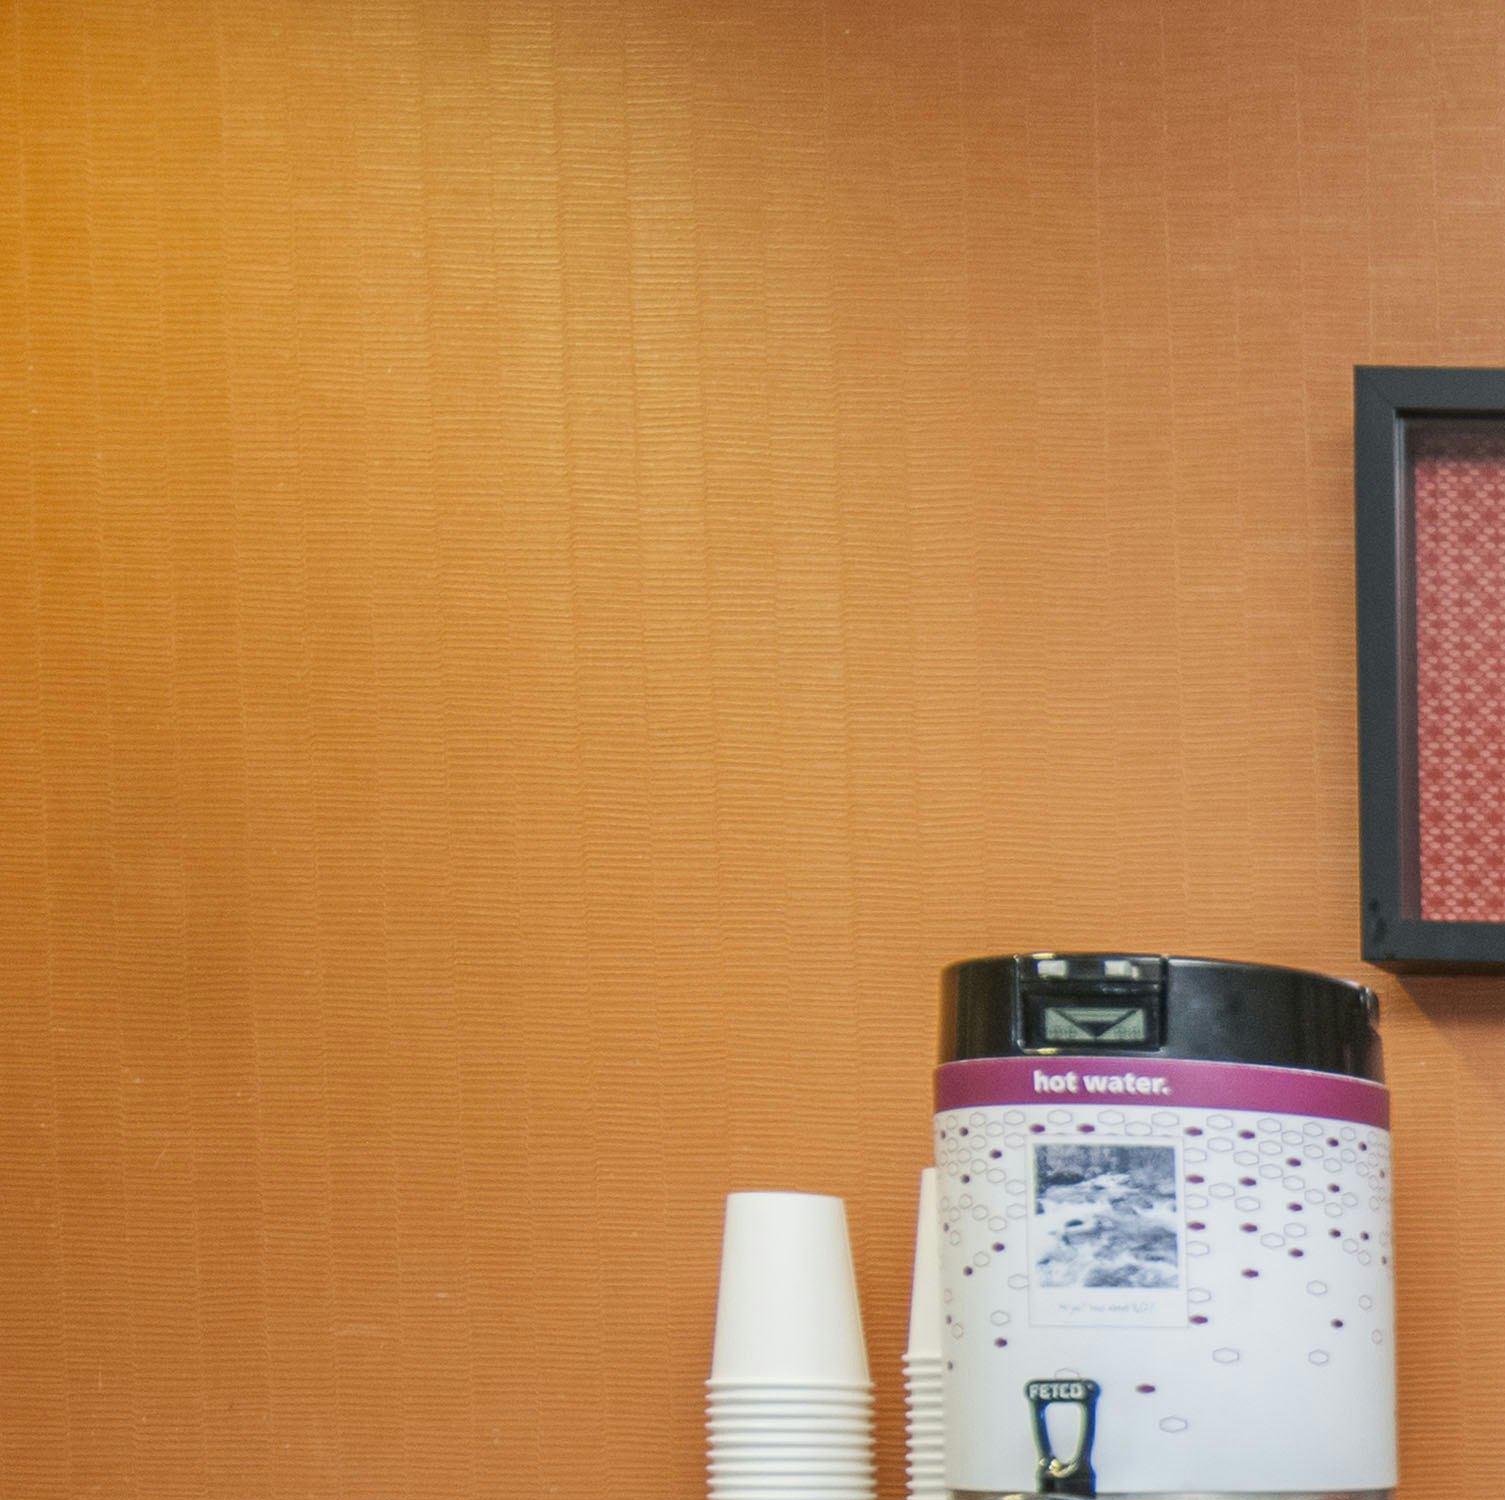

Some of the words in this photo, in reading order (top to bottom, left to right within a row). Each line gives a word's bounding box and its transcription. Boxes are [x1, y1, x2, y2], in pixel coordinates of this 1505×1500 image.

[1033, 1071, 1078, 1093] hot
[1083, 1073, 1170, 1095] water.
[1028, 1383, 1082, 1399] FETCO
